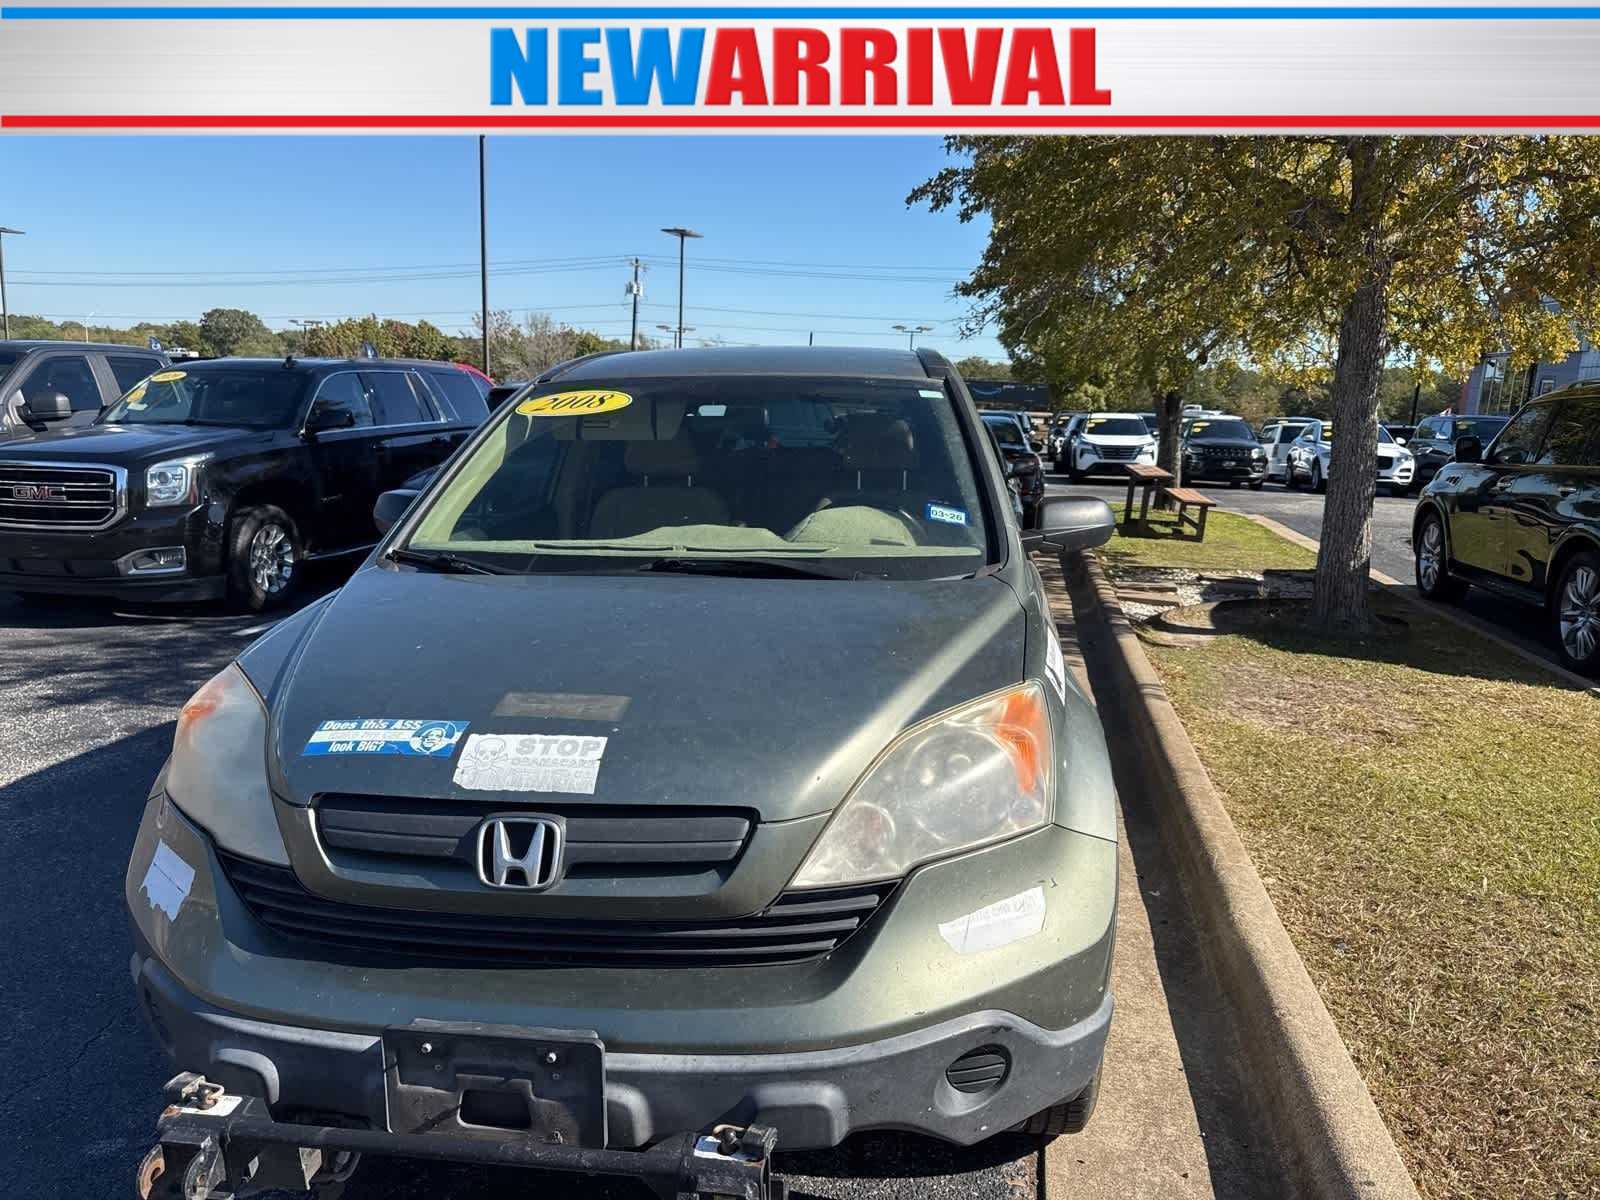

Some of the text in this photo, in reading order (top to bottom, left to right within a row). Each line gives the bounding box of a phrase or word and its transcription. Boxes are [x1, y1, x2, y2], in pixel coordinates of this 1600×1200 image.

[529, 393, 615, 412] 2008
[13, 485, 67, 500] GMC
[321, 719, 423, 730] Does this ASS
[327, 741, 386, 753] look BIG?
[515, 738, 601, 756] STOP
